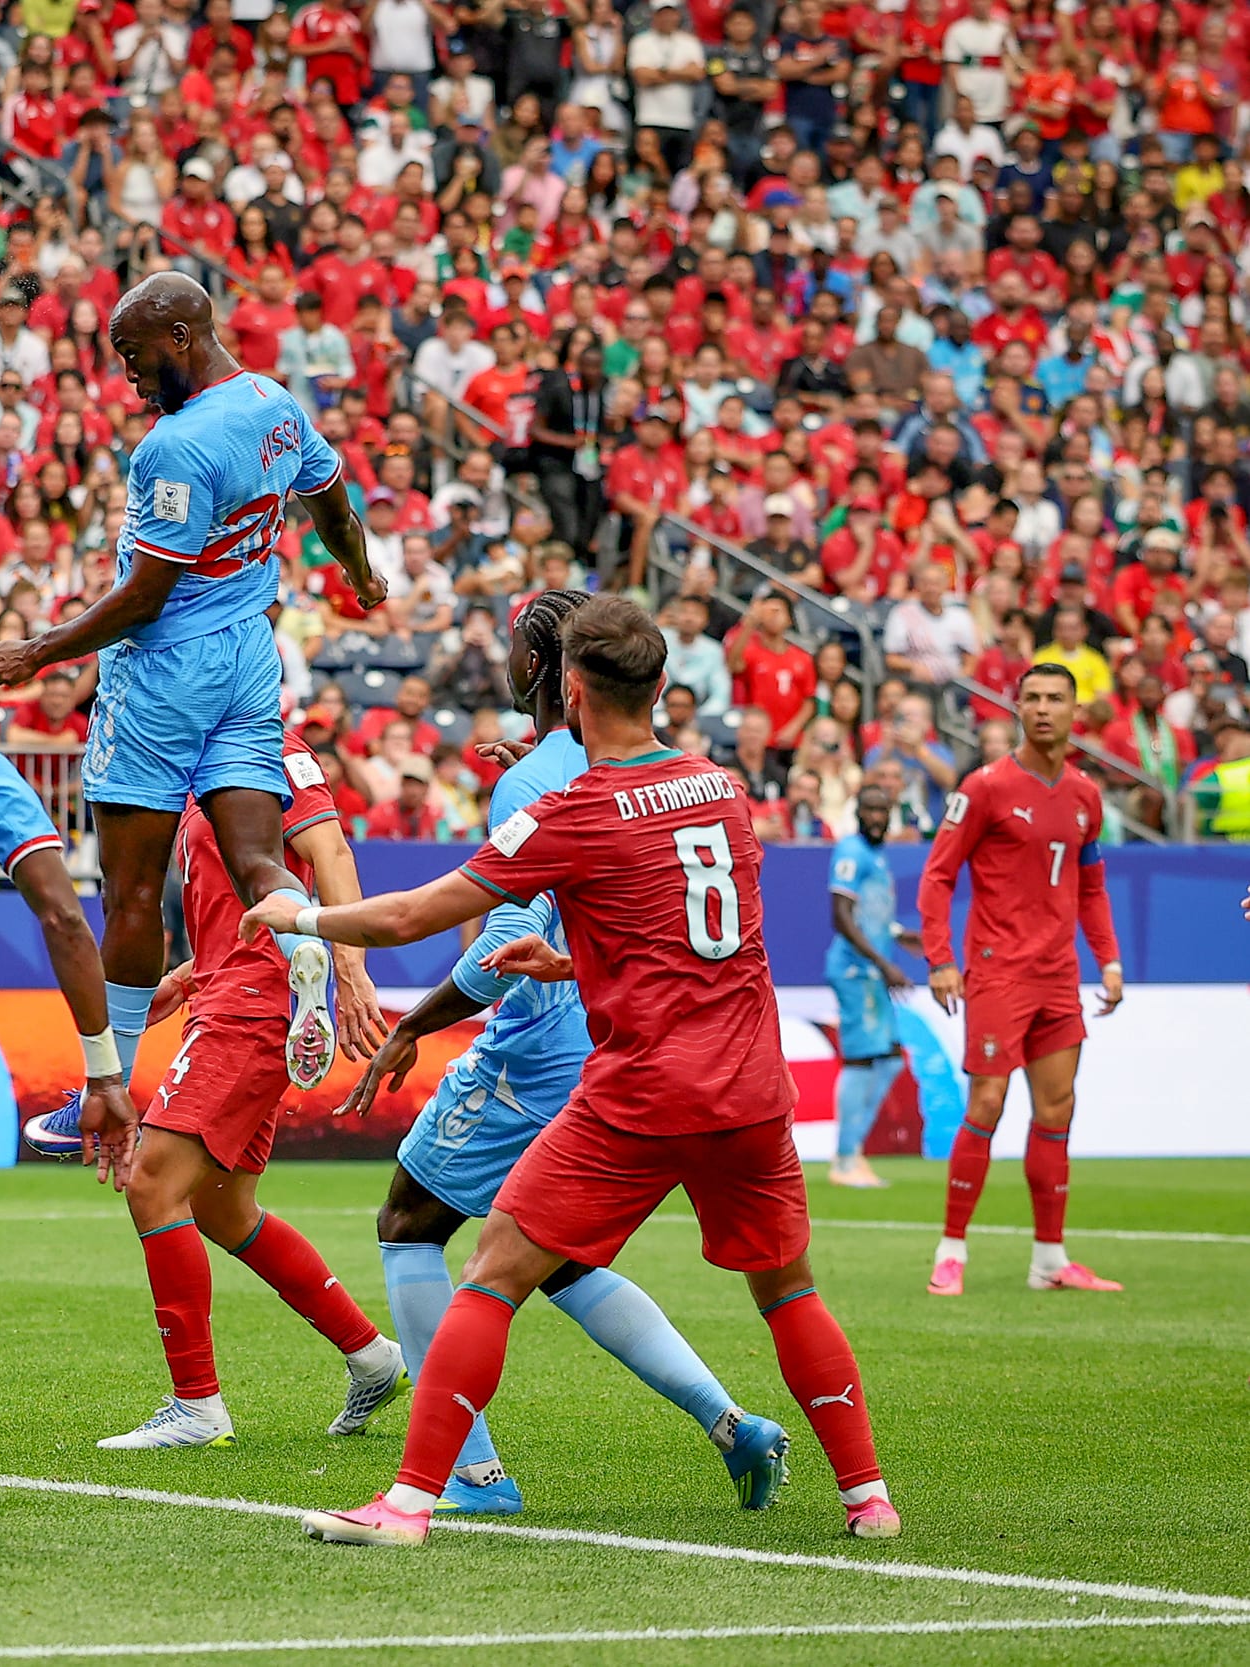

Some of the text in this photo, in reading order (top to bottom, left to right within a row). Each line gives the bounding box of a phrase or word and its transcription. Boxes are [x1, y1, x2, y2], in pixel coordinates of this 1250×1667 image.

[613, 771, 737, 821] B.FERNANDES
[671, 819, 743, 961] 8
[1048, 840, 1067, 888] 7
[169, 1028, 192, 1086] 4
